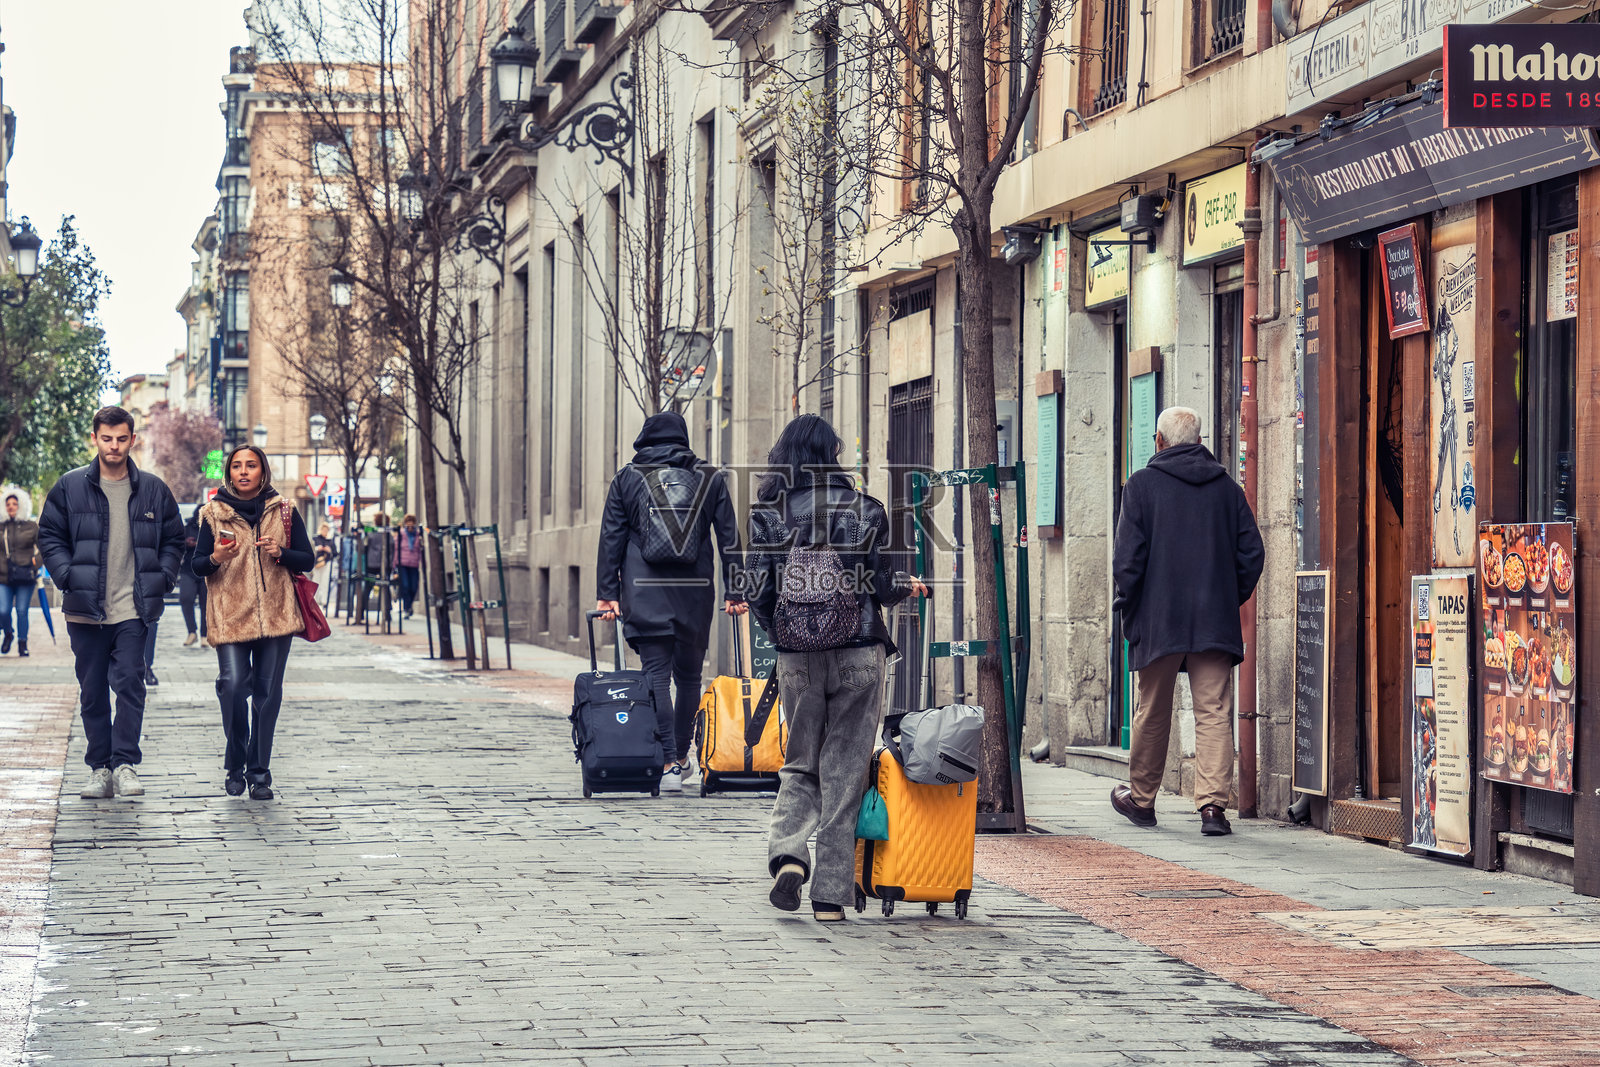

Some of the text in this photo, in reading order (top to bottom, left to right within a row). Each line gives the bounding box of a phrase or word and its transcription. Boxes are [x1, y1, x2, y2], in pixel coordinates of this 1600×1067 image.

[1302, 34, 1350, 88] CAFETERIA
[1405, 39, 1419, 58] PUB
[1469, 42, 1600, 81] Maho
[1473, 92, 1552, 108] DESDE
[1313, 151, 1397, 200] RESTAURANTE
[1391, 144, 1415, 175] MI
[1409, 128, 1469, 168] TABERNA
[1463, 128, 1485, 152] EL
[1446, 261, 1476, 293] BIENVENIDOS
[1450, 284, 1473, 312] WELCOME
[1438, 595, 1465, 615] TAPAS
